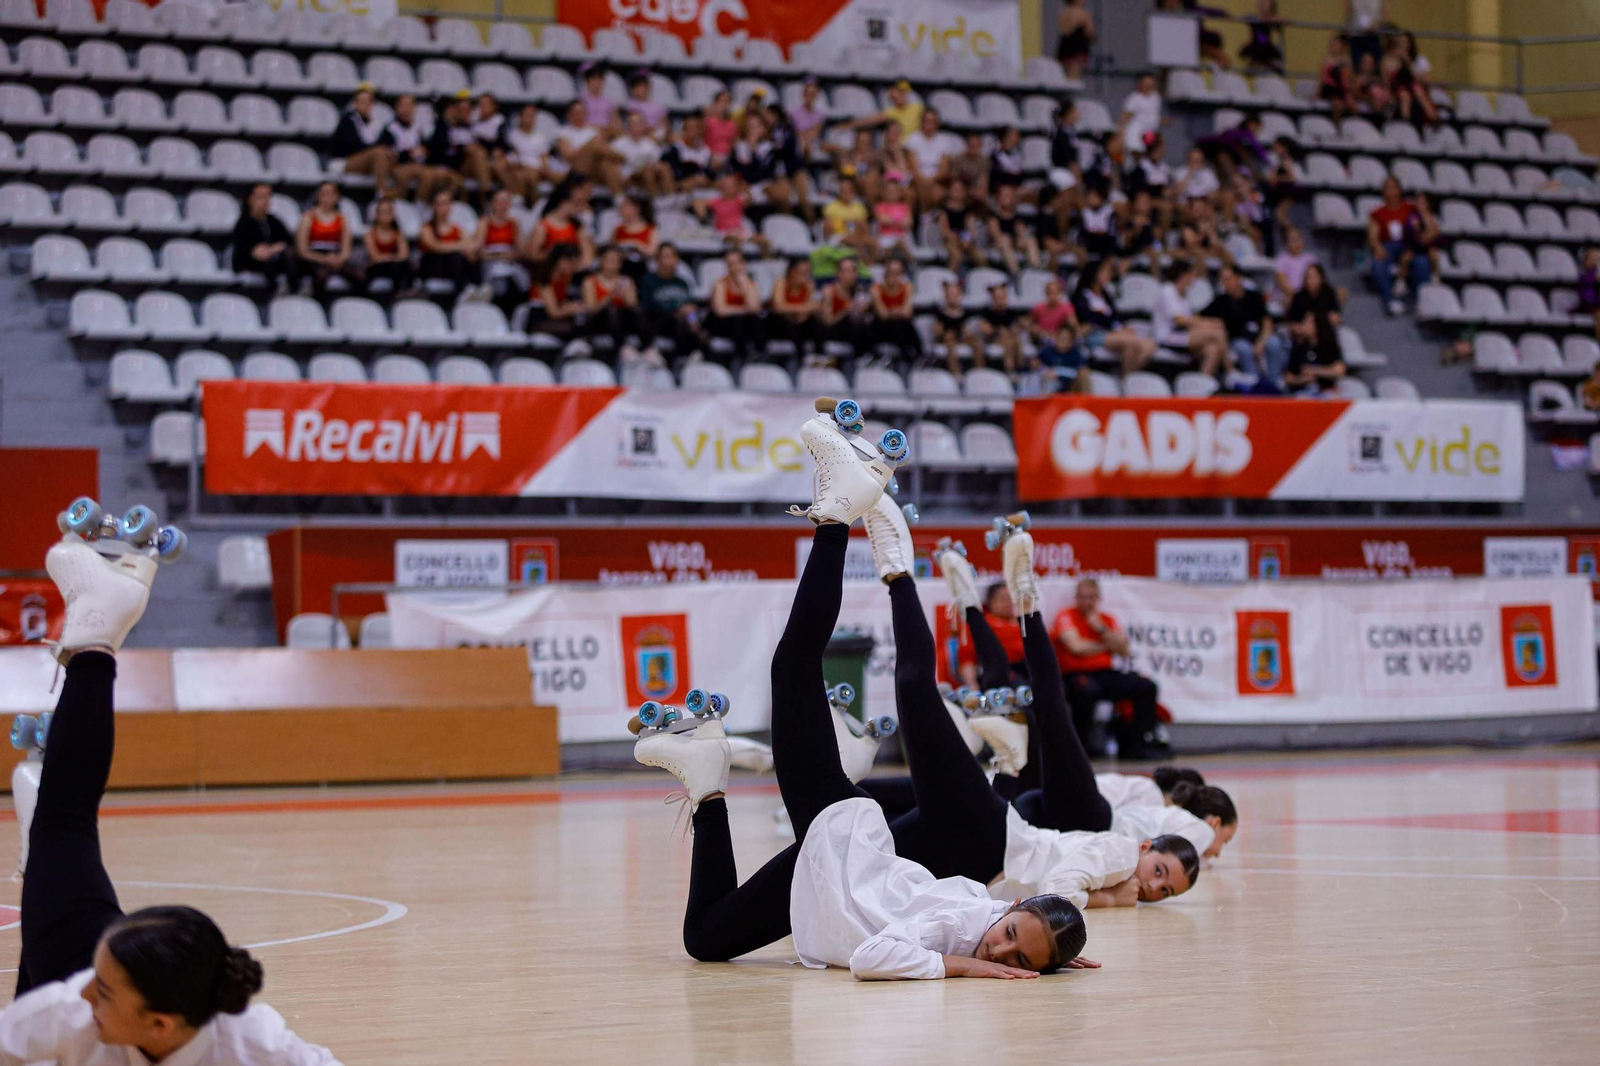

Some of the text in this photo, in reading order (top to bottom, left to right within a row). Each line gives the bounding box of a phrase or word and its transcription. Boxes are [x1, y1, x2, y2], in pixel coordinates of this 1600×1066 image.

[287, 408, 460, 464] Recalvi
[671, 420, 806, 473] vide
[1051, 407, 1253, 478] GADIS
[1394, 425, 1502, 475] vide
[1128, 625, 1216, 650] NCELLO
[1367, 622, 1483, 648] CONCELLO
[531, 666, 587, 692] IGO
[1384, 650, 1472, 676] DE VIGO
